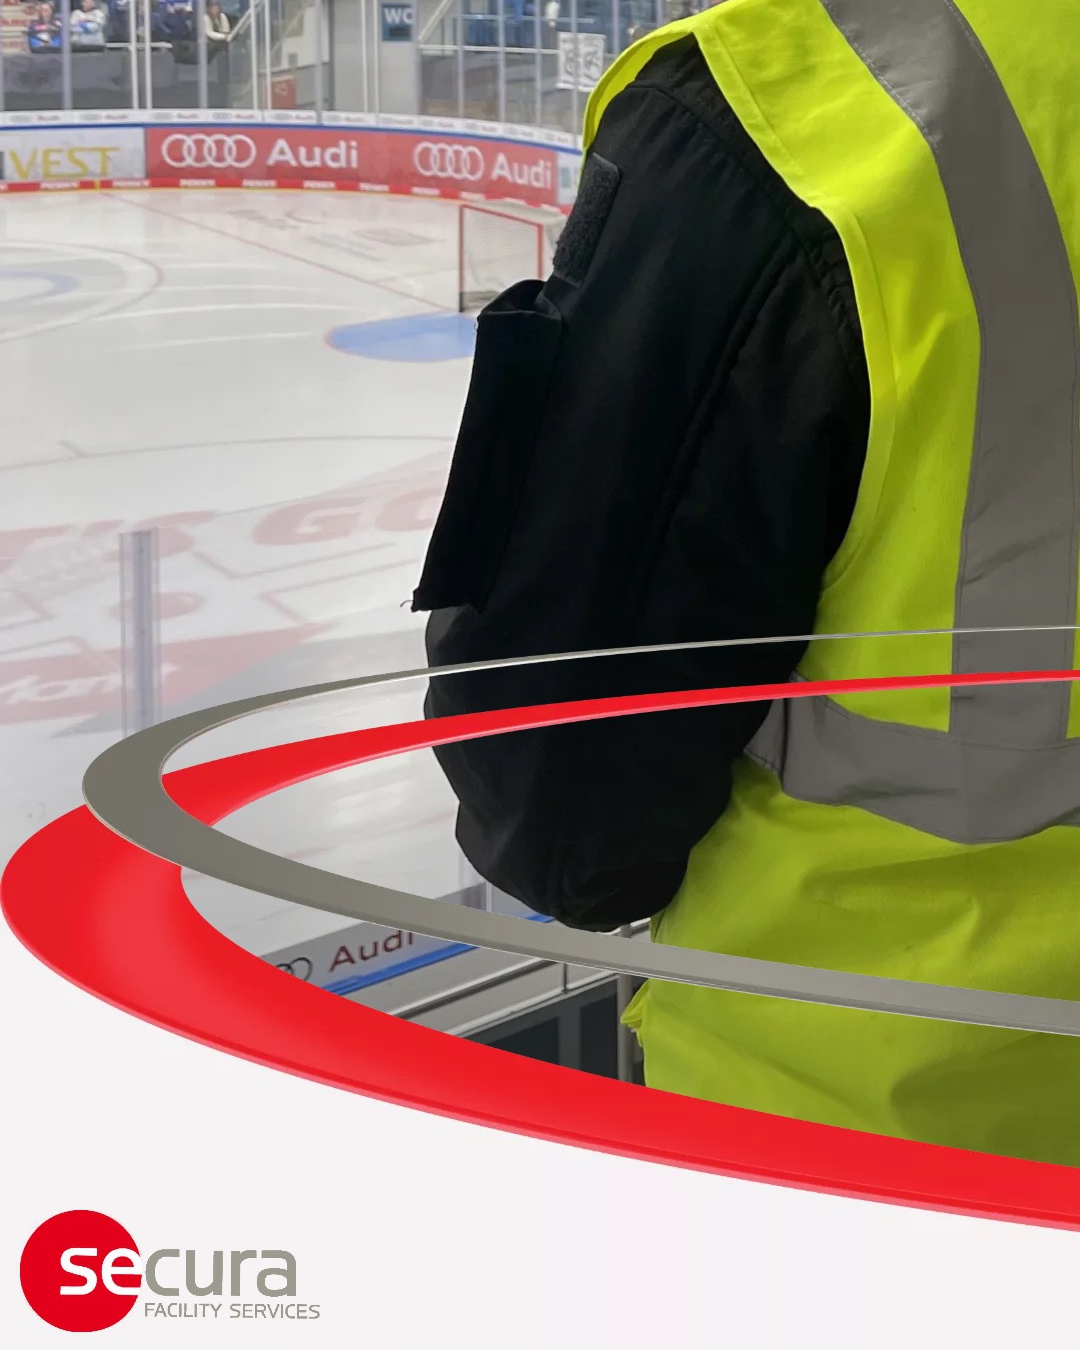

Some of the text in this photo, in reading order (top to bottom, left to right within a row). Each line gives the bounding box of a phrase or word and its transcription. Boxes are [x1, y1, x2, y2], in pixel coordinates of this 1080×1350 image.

[267, 138, 358, 169] Audi
[491, 152, 552, 189] Audi
[329, 929, 415, 973] Audi
